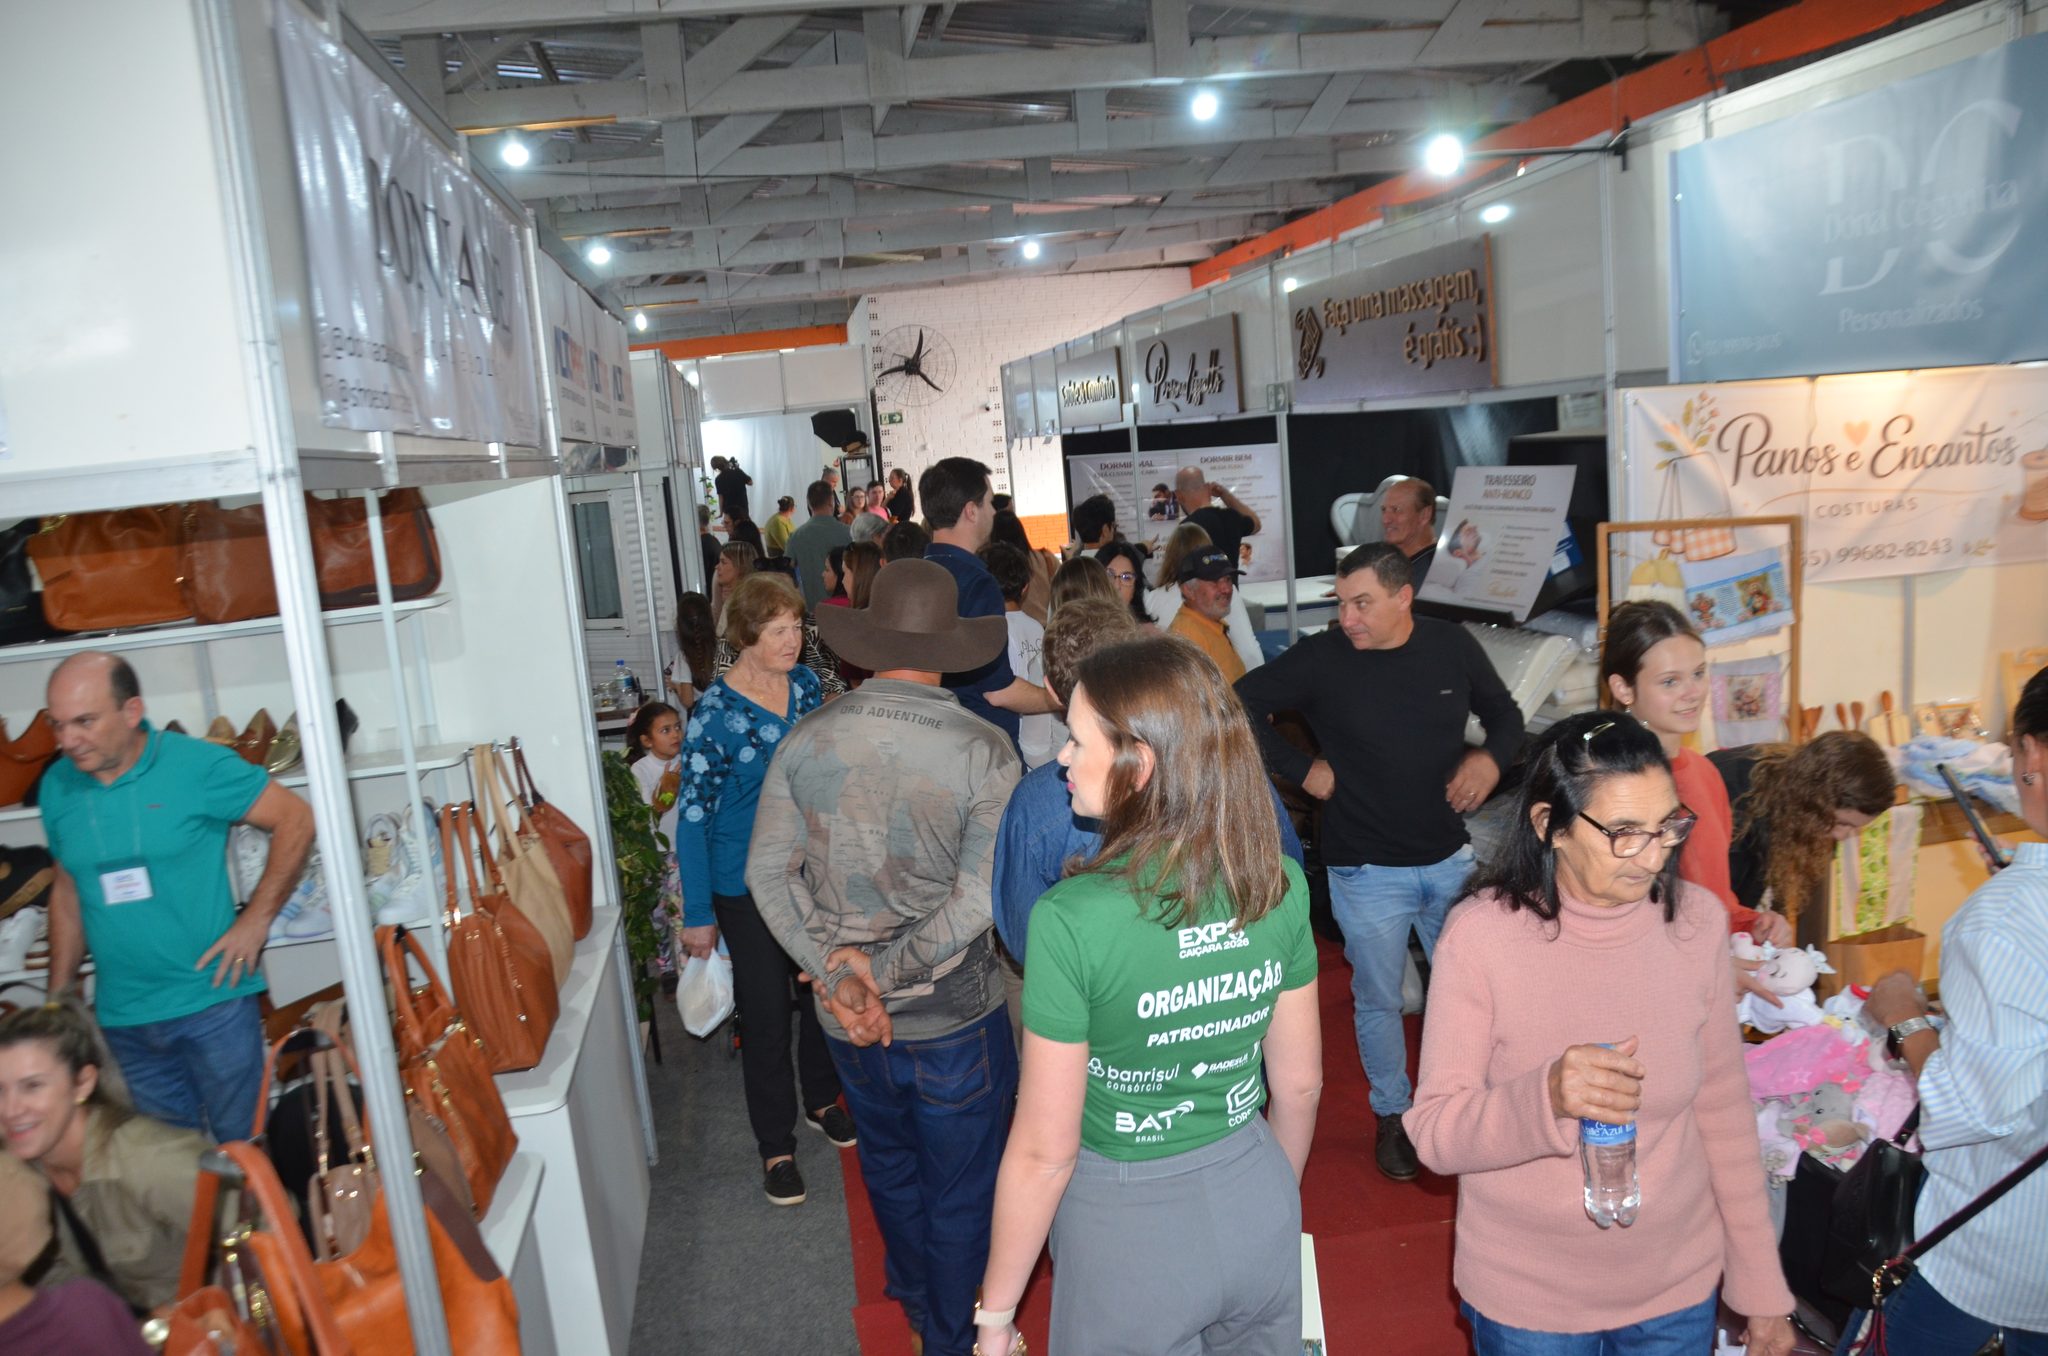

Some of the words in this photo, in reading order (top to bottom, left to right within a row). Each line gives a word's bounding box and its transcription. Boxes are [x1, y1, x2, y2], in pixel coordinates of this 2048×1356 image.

[1322, 298, 1351, 335] Faça
[1353, 290, 1385, 322] uma
[1837, 297, 1984, 334] Personalizados
[1403, 322, 1417, 363] é
[1418, 316, 1466, 369] grátis
[1716, 411, 1840, 487] Panos
[1845, 449, 1866, 472] e
[1870, 413, 2020, 480] Encantos
[1814, 496, 1918, 520] COSTURAS
[1837, 536, 1953, 564] 99682-8243
[866, 706, 944, 730] ADVENTURE
[1179, 942, 1223, 959] CAIÇARA
[1137, 959, 1283, 1019] ORGANIZAÇÃO
[1146, 1006, 1270, 1048] PATROCINADOR
[1106, 1080, 1163, 1093] consórcio
[1107, 1063, 1180, 1083] banrisul
[1115, 1106, 1178, 1134] BAT
[1135, 1134, 1165, 1143] BRASIL
